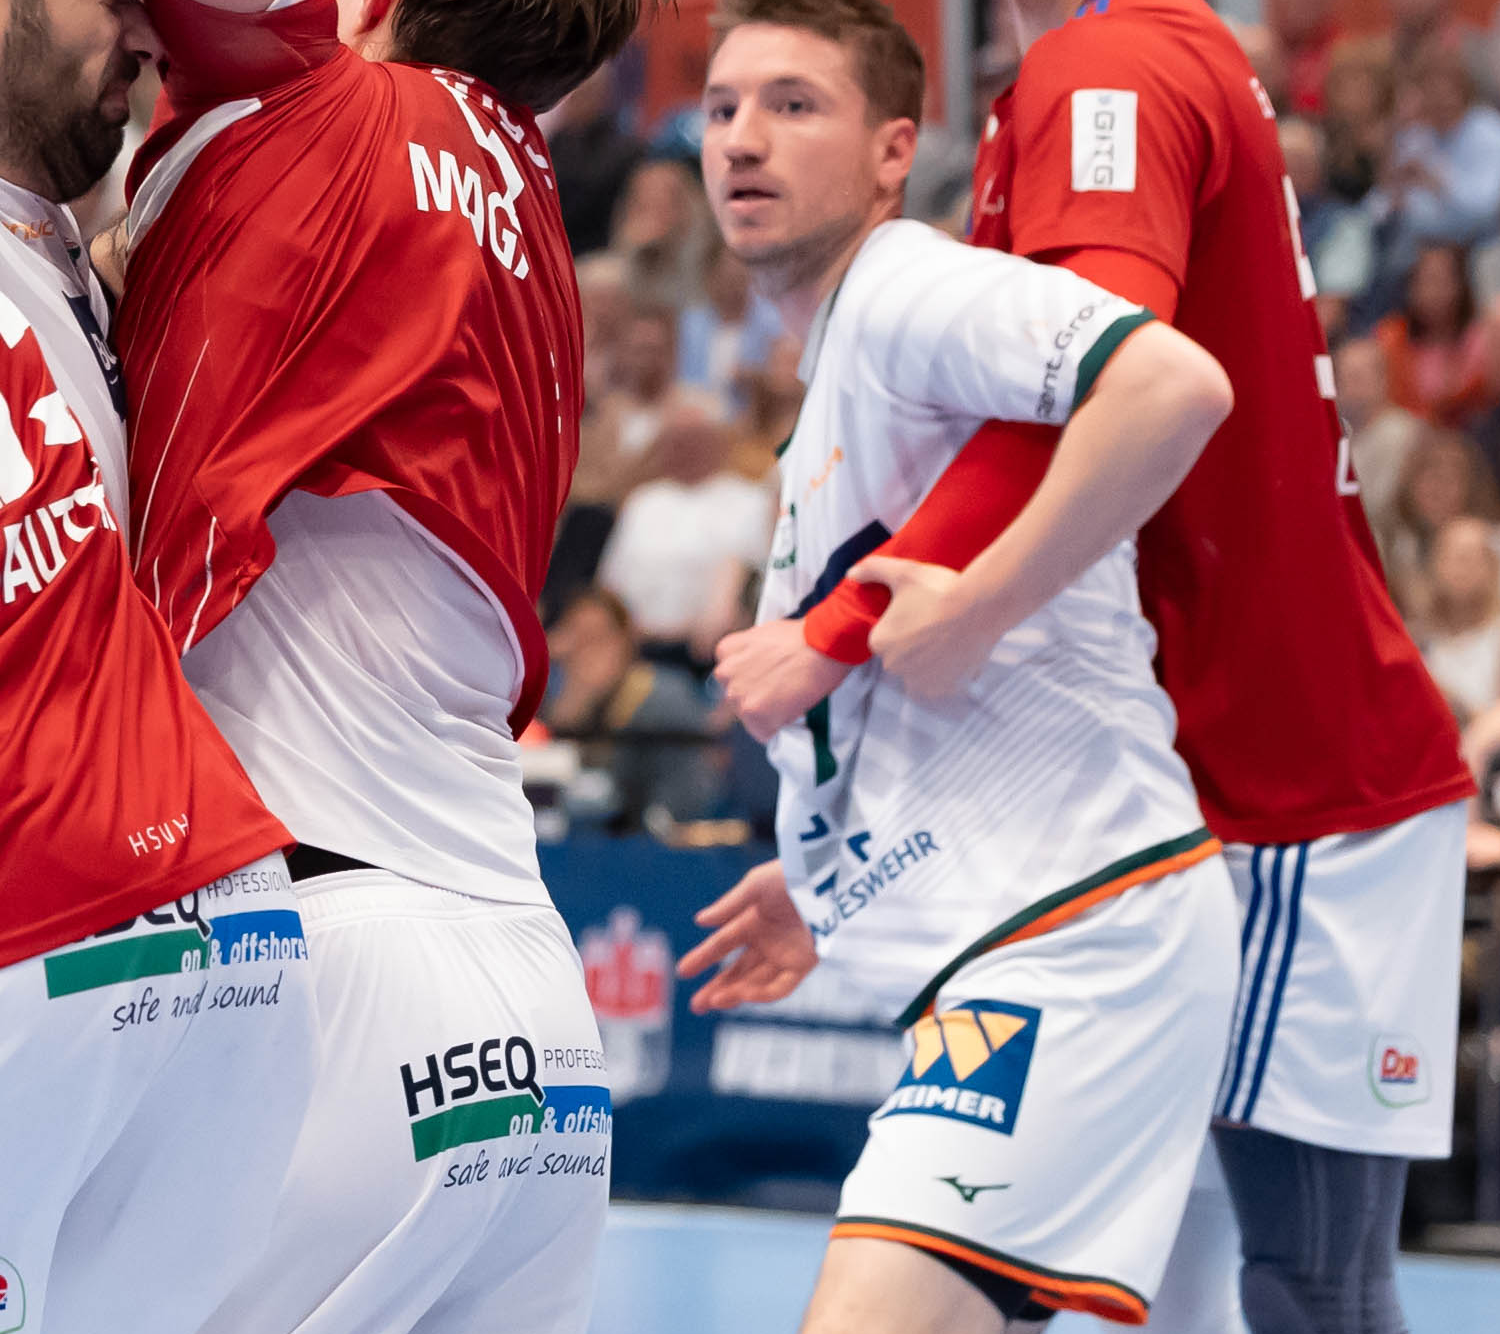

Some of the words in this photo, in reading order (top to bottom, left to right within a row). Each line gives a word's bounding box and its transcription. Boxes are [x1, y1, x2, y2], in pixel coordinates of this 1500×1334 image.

[128, 813, 190, 857] HSVH
[180, 949, 202, 972] on
[229, 931, 309, 964] offshore
[112, 986, 161, 1031] safe
[171, 980, 209, 1018] and
[208, 970, 283, 1010] sound
[400, 1036, 546, 1117] HSEQ
[509, 1113, 534, 1136] on
[540, 1106, 558, 1134] &
[444, 1149, 489, 1187] safe
[537, 1144, 608, 1176] sound
